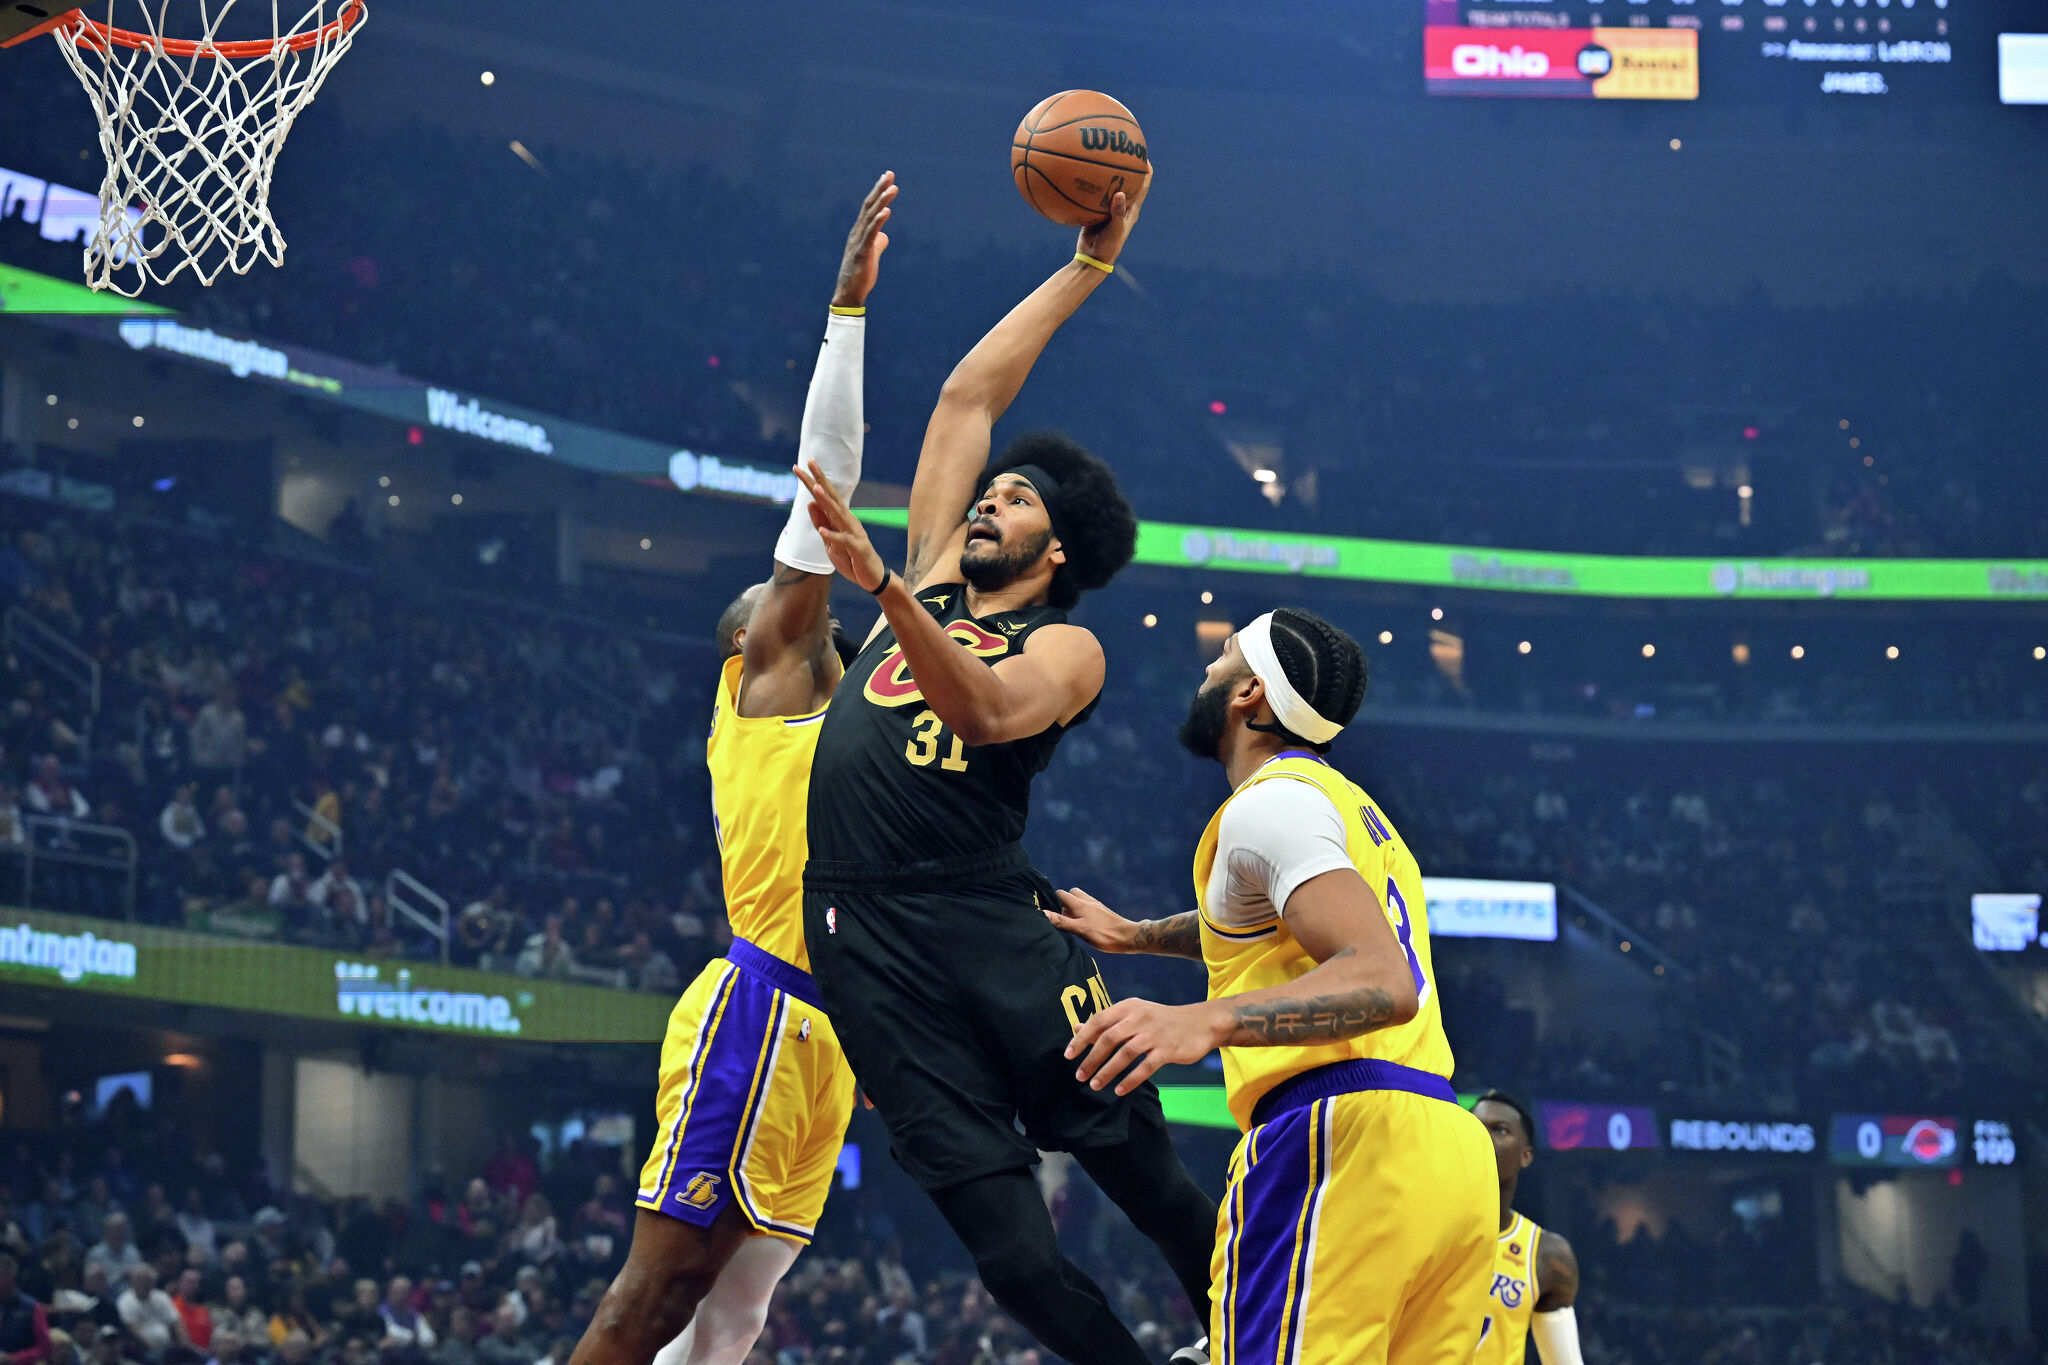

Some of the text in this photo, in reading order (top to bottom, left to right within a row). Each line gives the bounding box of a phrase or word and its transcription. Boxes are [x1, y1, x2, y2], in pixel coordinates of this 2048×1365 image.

[1453, 44, 1549, 77] Ohio
[155, 320, 288, 378] Huntington
[1215, 531, 1340, 575] Huntington
[1743, 561, 1870, 598] Huntington
[905, 709, 969, 773] 31
[0, 924, 137, 982] ntington
[335, 960, 521, 1034] Welcome.
[1607, 1111, 1633, 1151] 0
[1671, 1119, 1816, 1153] REBOUNDS
[1857, 1121, 1882, 1159] 0
